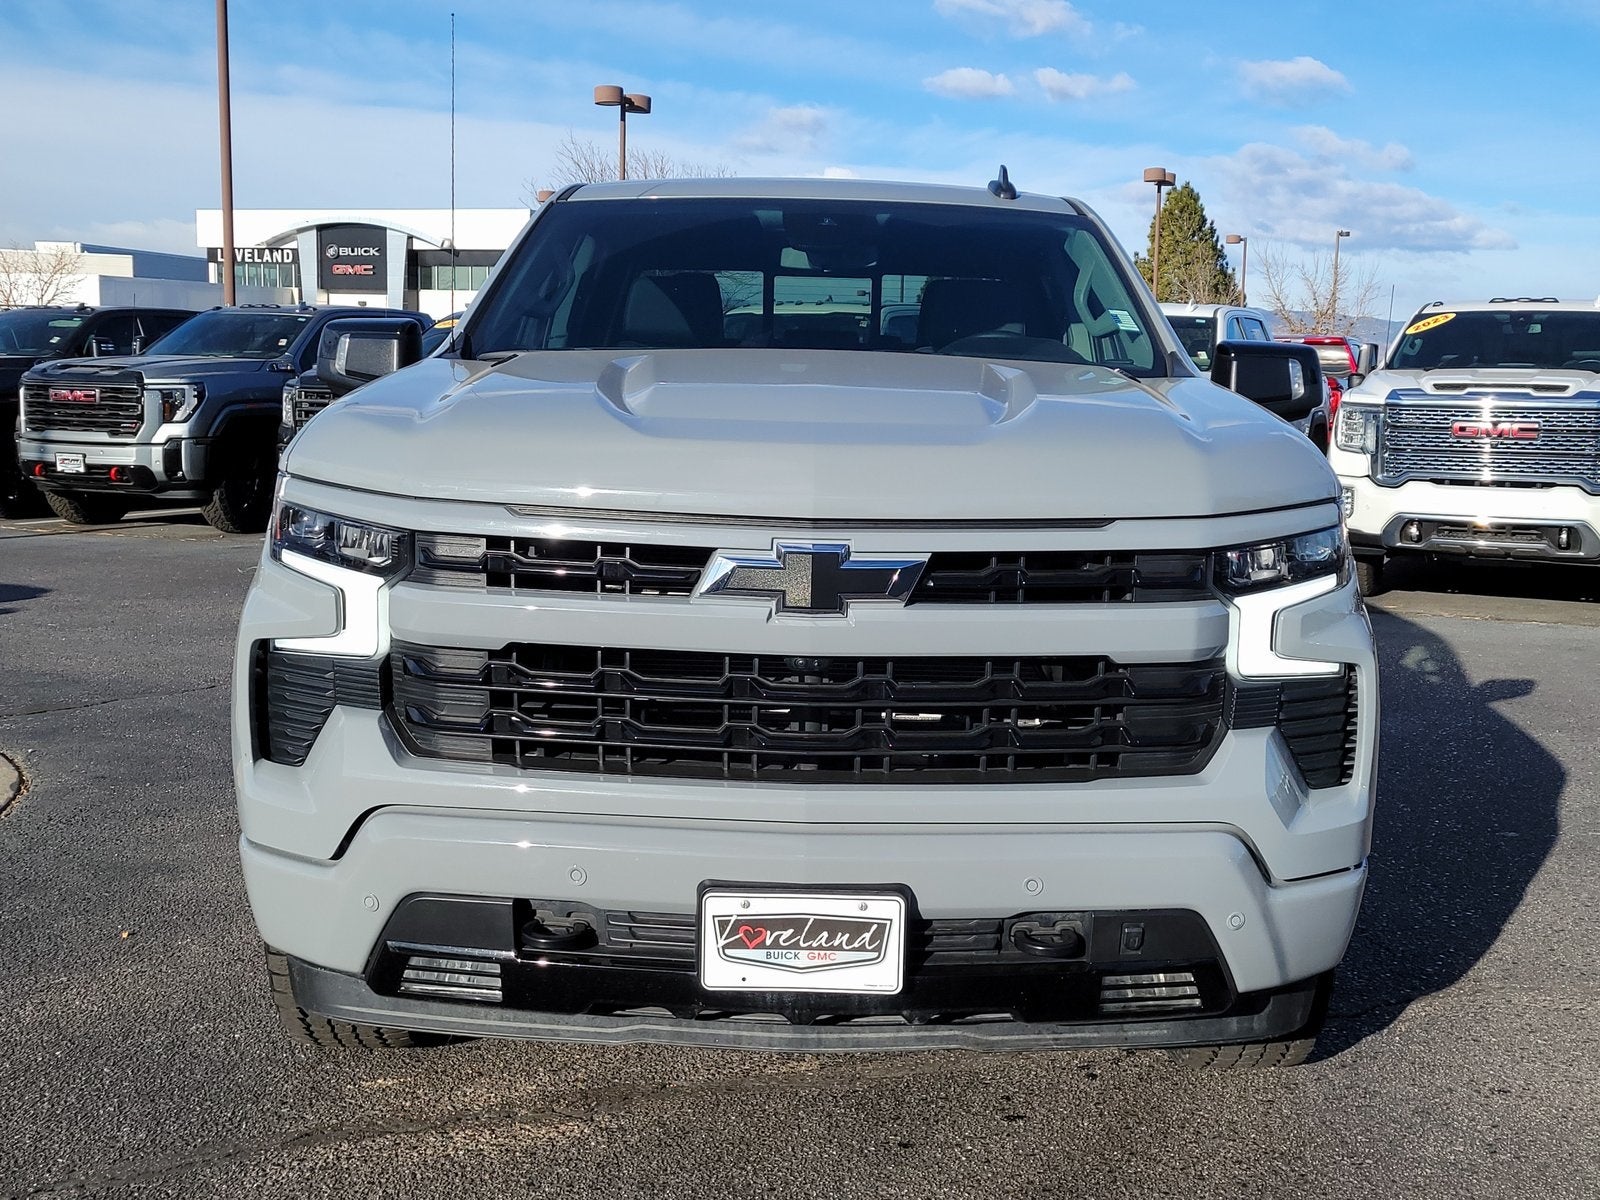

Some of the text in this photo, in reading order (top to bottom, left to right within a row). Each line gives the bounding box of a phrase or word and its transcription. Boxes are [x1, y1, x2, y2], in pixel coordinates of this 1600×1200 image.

[217, 249, 293, 263] LVELAND
[339, 247, 380, 256] BUICK
[332, 264, 374, 275] GMC
[51, 389, 96, 401] GMC
[1452, 421, 1540, 439] GMC
[765, 951, 837, 961] BUICK GMC
